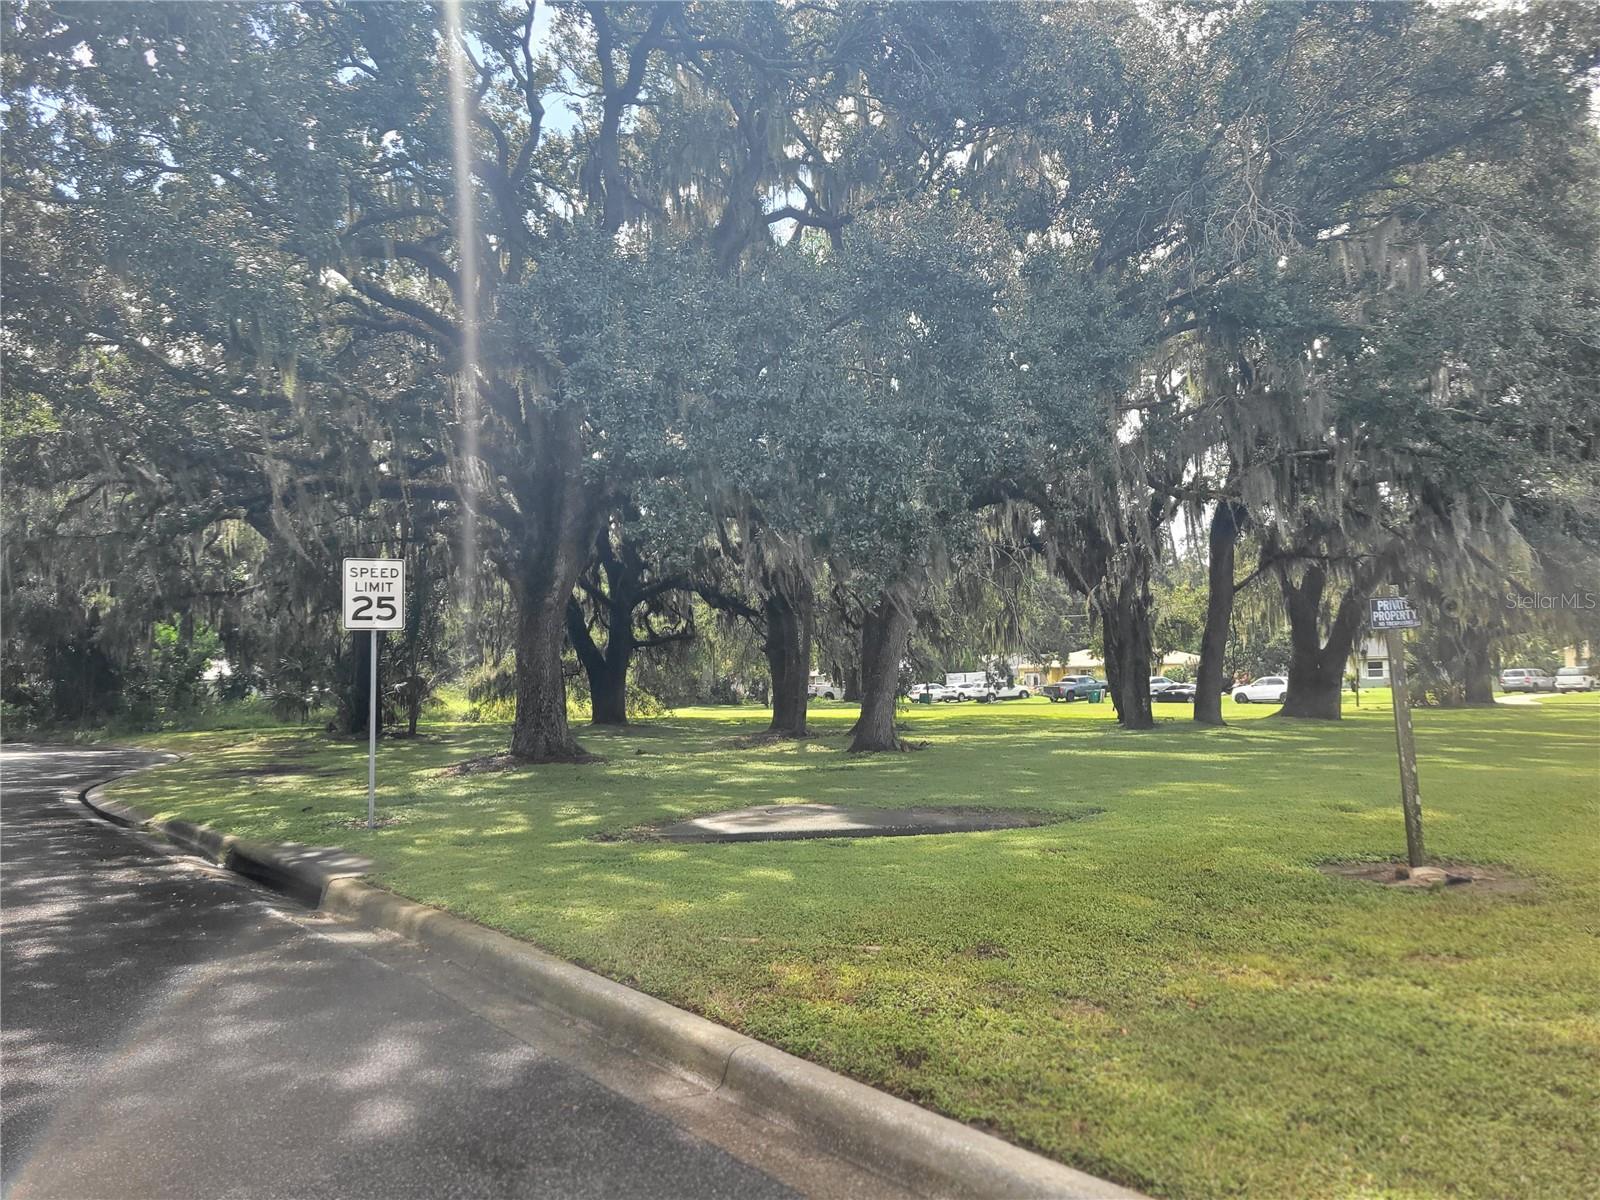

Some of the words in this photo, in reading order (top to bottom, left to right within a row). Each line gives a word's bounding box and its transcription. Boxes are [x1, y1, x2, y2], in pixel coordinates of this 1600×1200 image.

[350, 567, 399, 578] SPEED
[355, 582, 394, 592] LIMIT
[352, 596, 397, 621] 25
[1377, 600, 1410, 611] PRIVATE
[1373, 610, 1417, 621] PROPERTY
